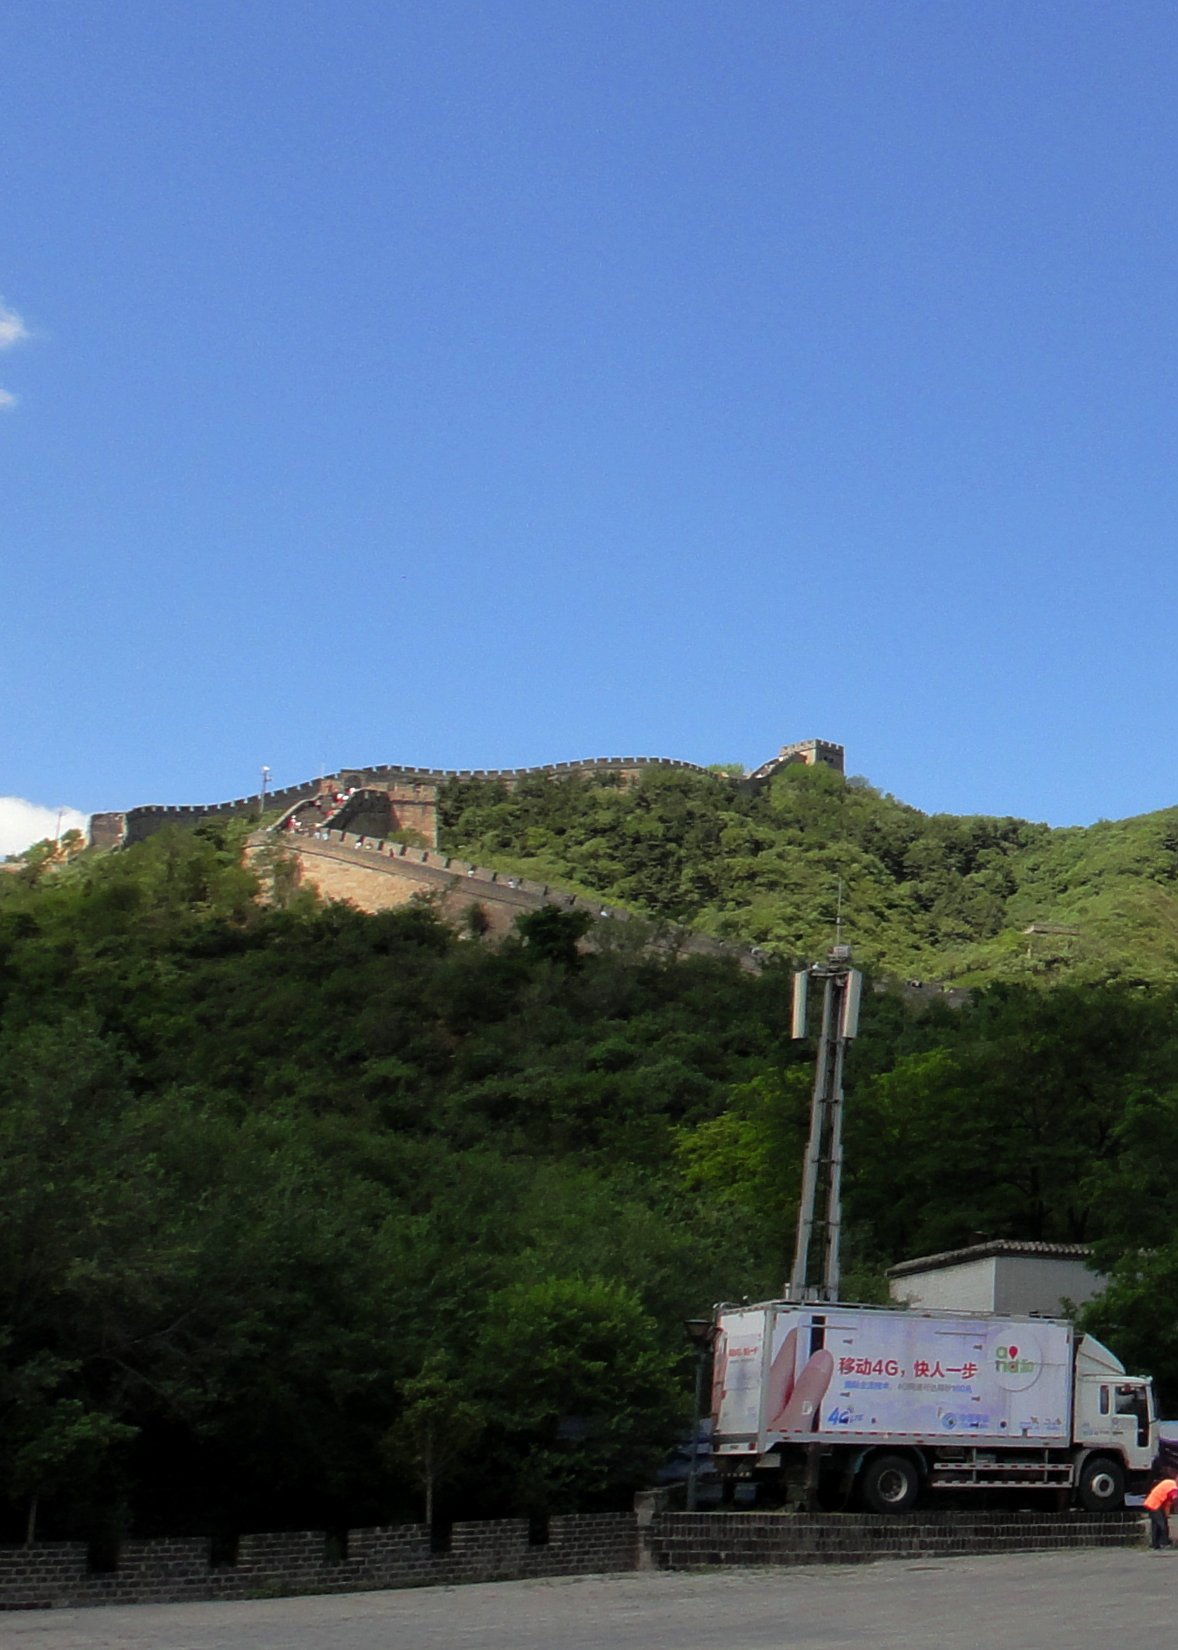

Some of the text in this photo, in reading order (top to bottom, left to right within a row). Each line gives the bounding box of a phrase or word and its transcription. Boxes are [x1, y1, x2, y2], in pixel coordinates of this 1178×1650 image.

[839, 1357, 978, 1380] 移动4G，快人一步
